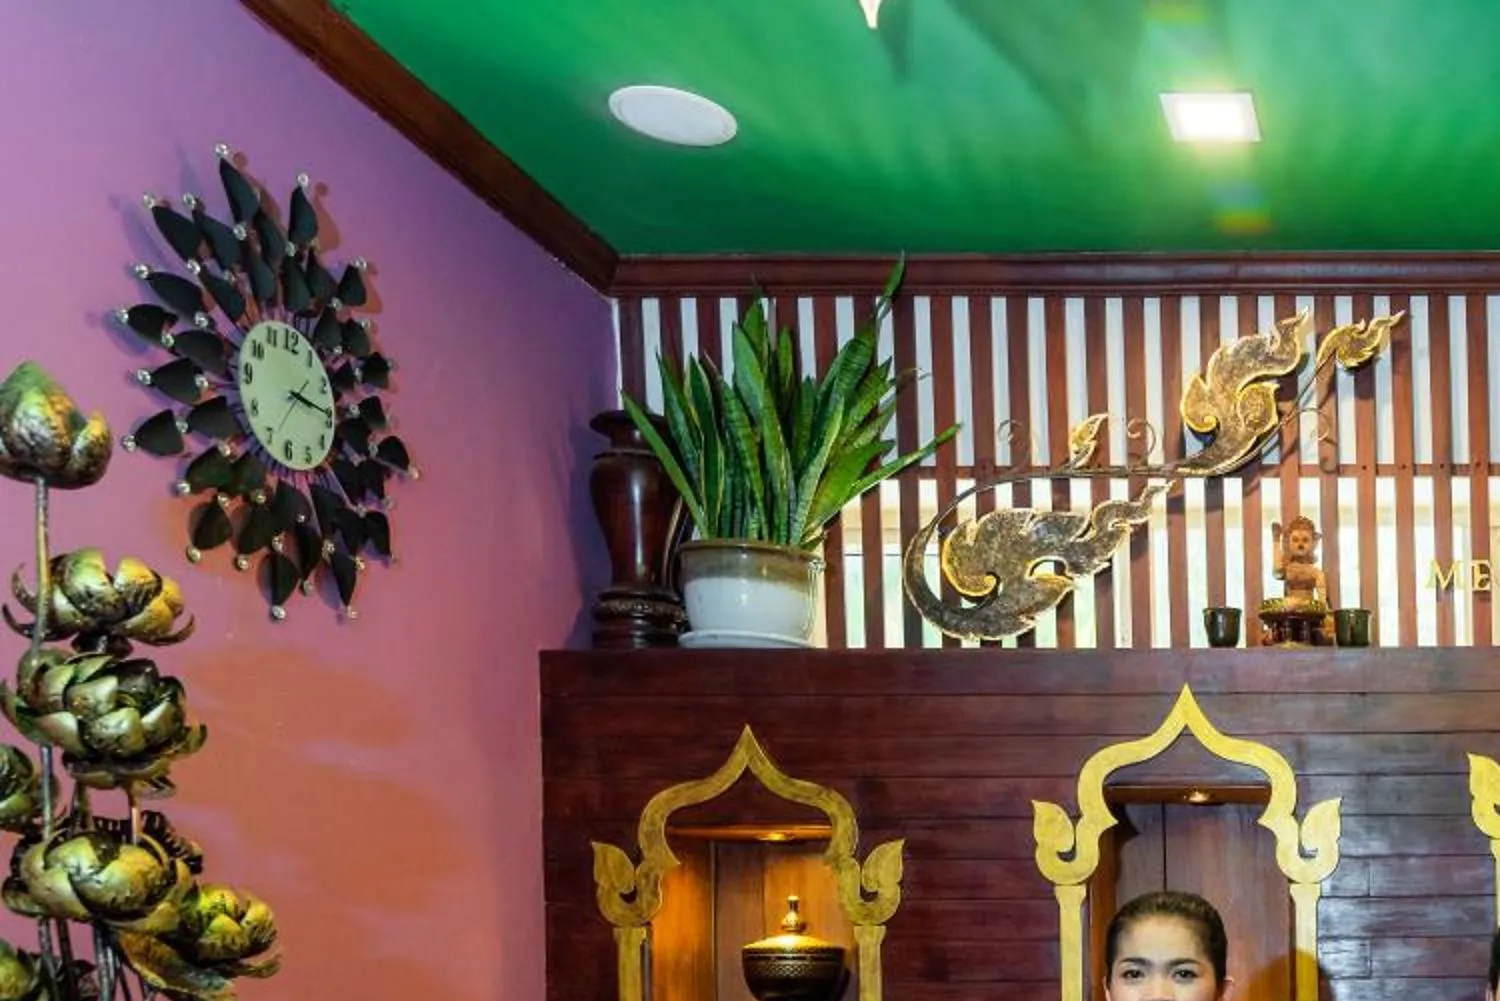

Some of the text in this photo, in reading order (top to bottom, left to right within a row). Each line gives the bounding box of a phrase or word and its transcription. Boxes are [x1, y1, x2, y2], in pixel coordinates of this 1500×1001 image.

[266, 326, 278, 348] 11
[284, 328, 299, 355] 12
[252, 340, 265, 360] 10
[307, 350, 313, 368] 1
[244, 362, 253, 385] 9
[320, 376, 328, 394] 2
[266, 426, 273, 445] 7
[284, 440, 293, 461] 6
[305, 446, 313, 464] 5
